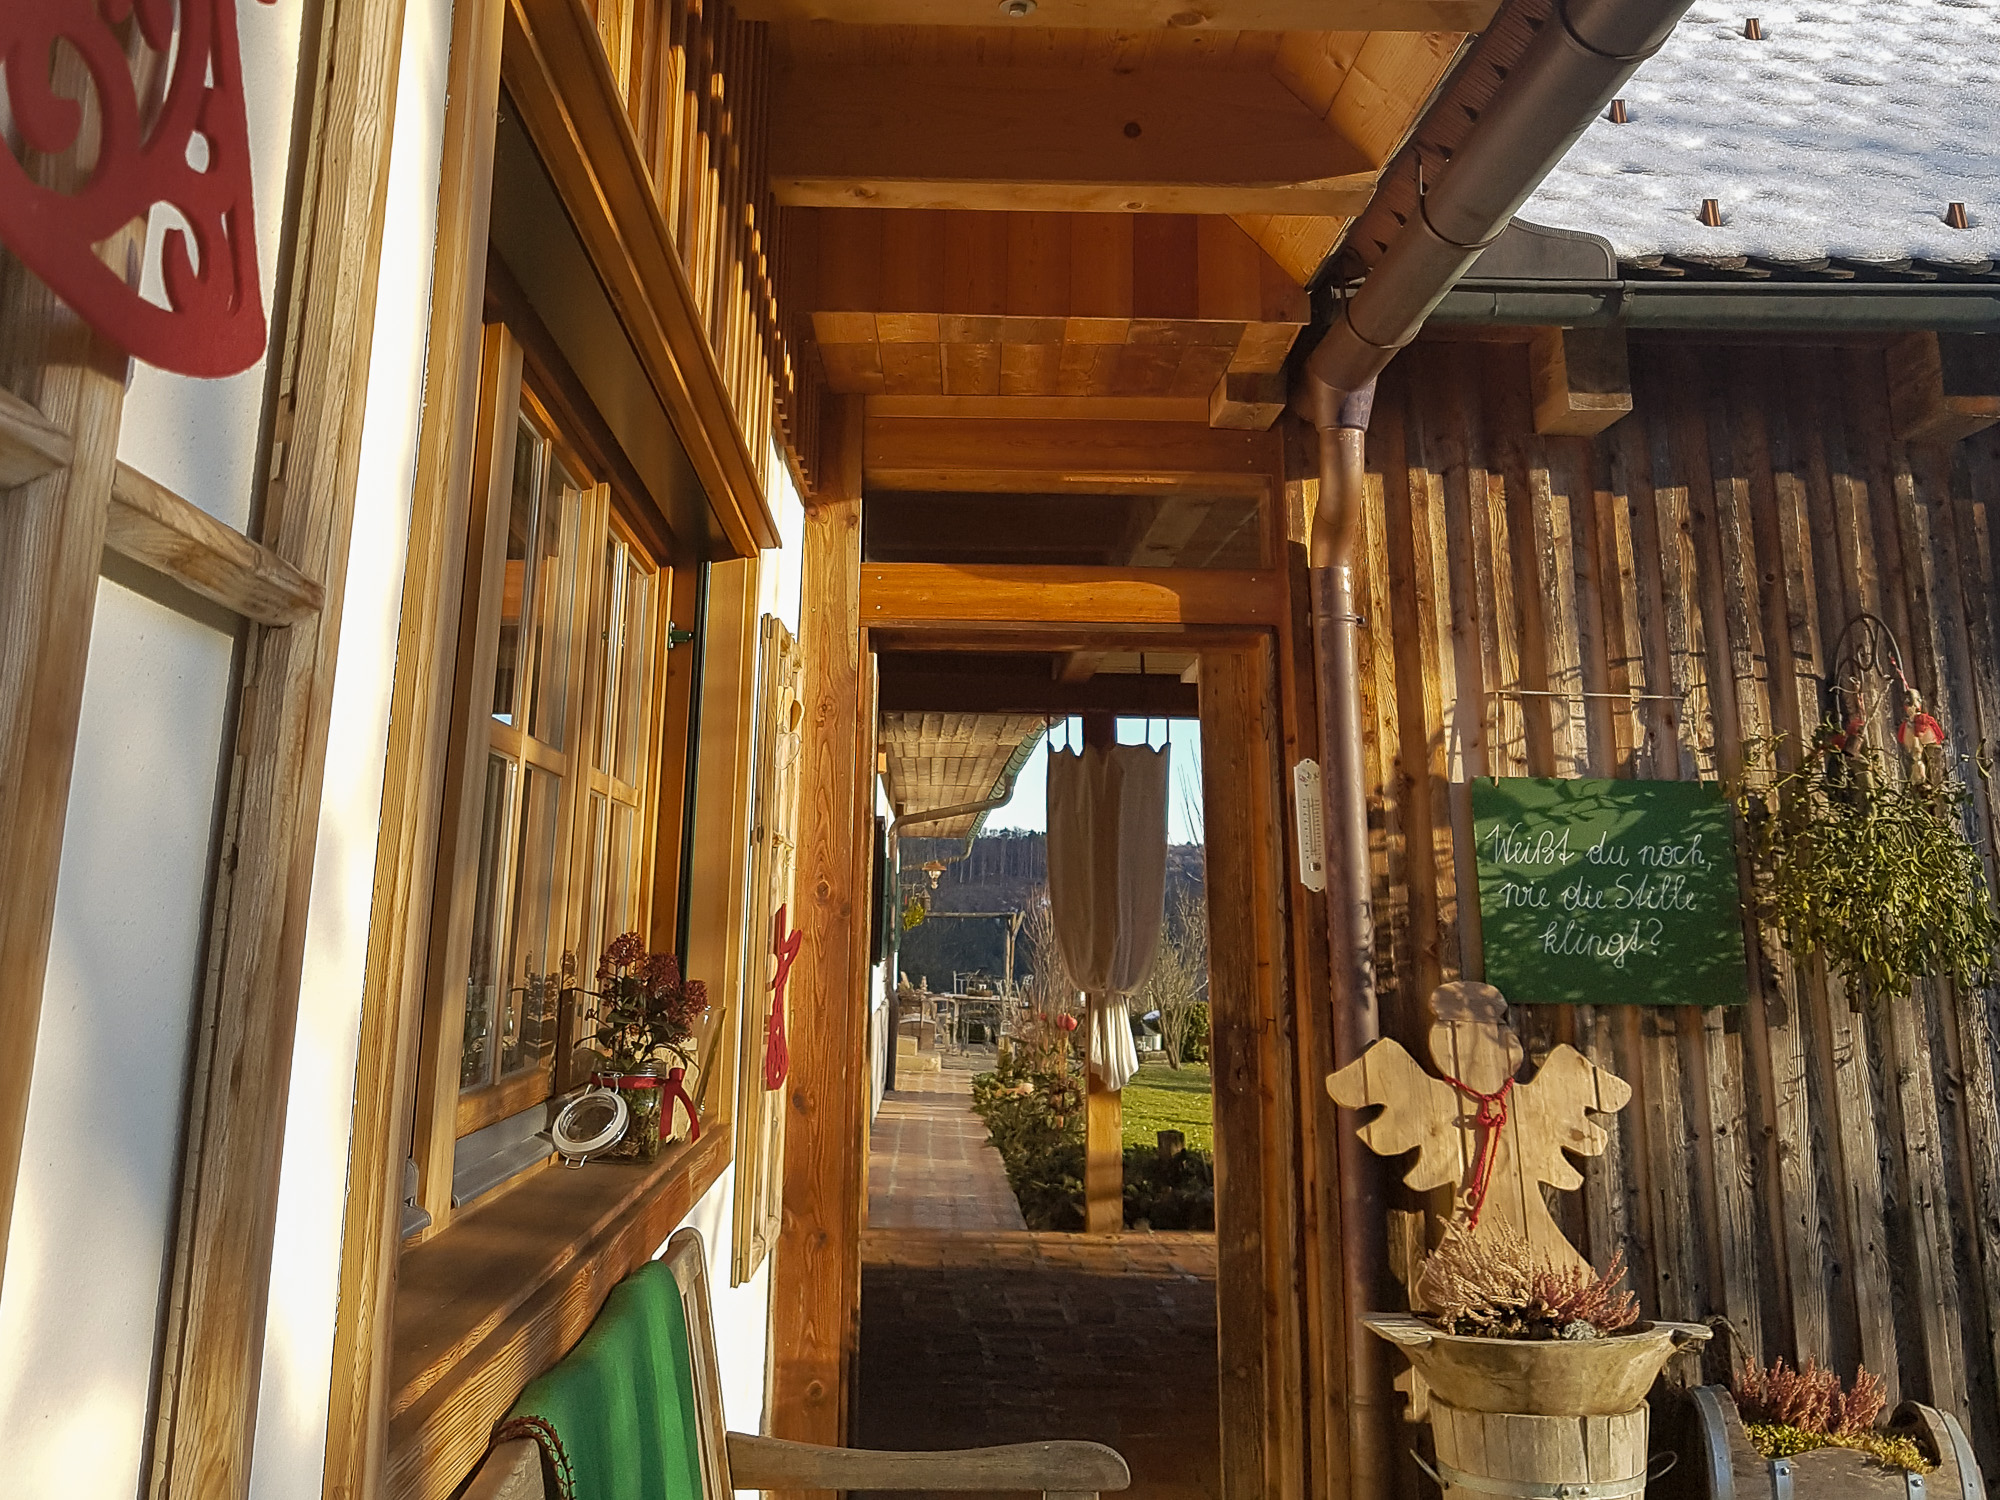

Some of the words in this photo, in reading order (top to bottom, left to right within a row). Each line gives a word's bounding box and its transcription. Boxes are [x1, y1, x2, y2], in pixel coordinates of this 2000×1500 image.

[1485, 822, 1575, 866] Weißt
[1586, 831, 1630, 867] du
[1638, 834, 1713, 871] noch,
[1561, 876, 1606, 911] die
[1615, 873, 1697, 911] Stille
[1539, 917, 1664, 969] klingt?
